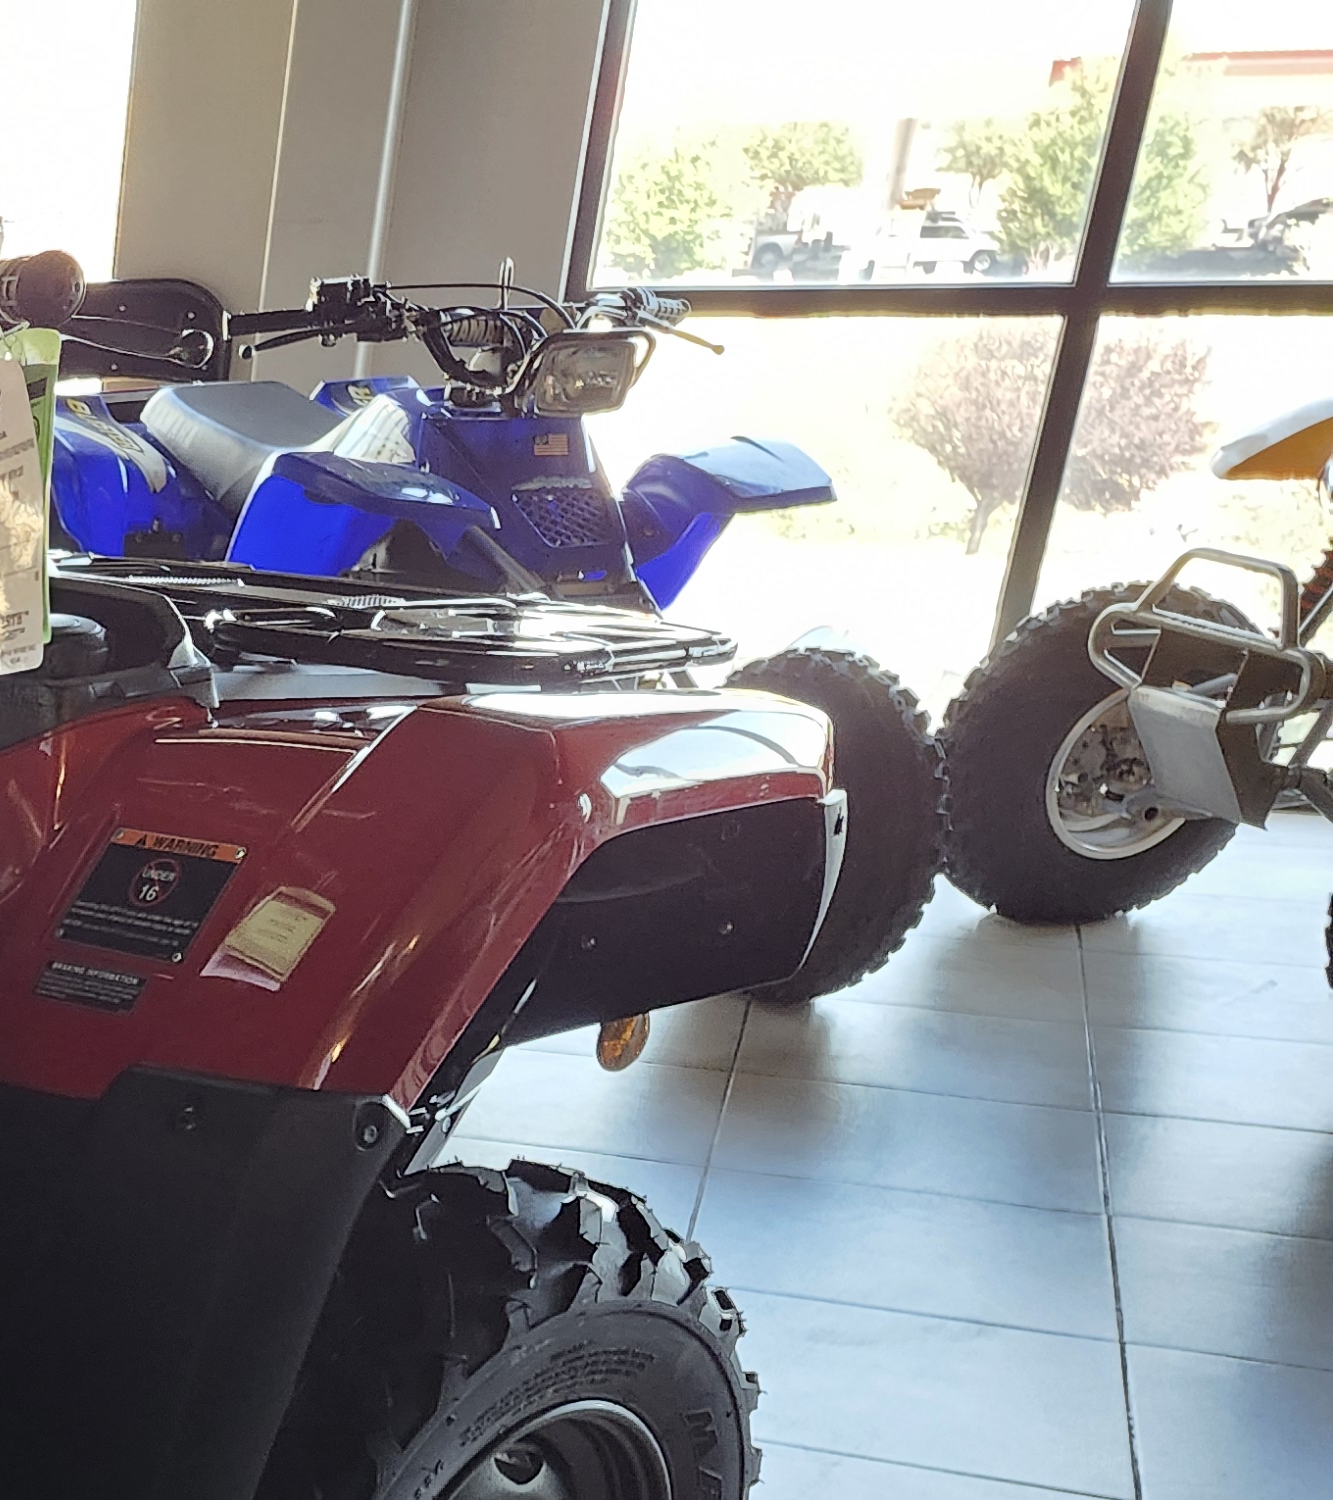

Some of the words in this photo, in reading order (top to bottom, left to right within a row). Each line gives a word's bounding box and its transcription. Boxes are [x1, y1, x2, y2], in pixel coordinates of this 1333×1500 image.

[152, 836, 220, 858] WARNING
[141, 867, 178, 883] UNDER
[138, 882, 161, 902] 16
